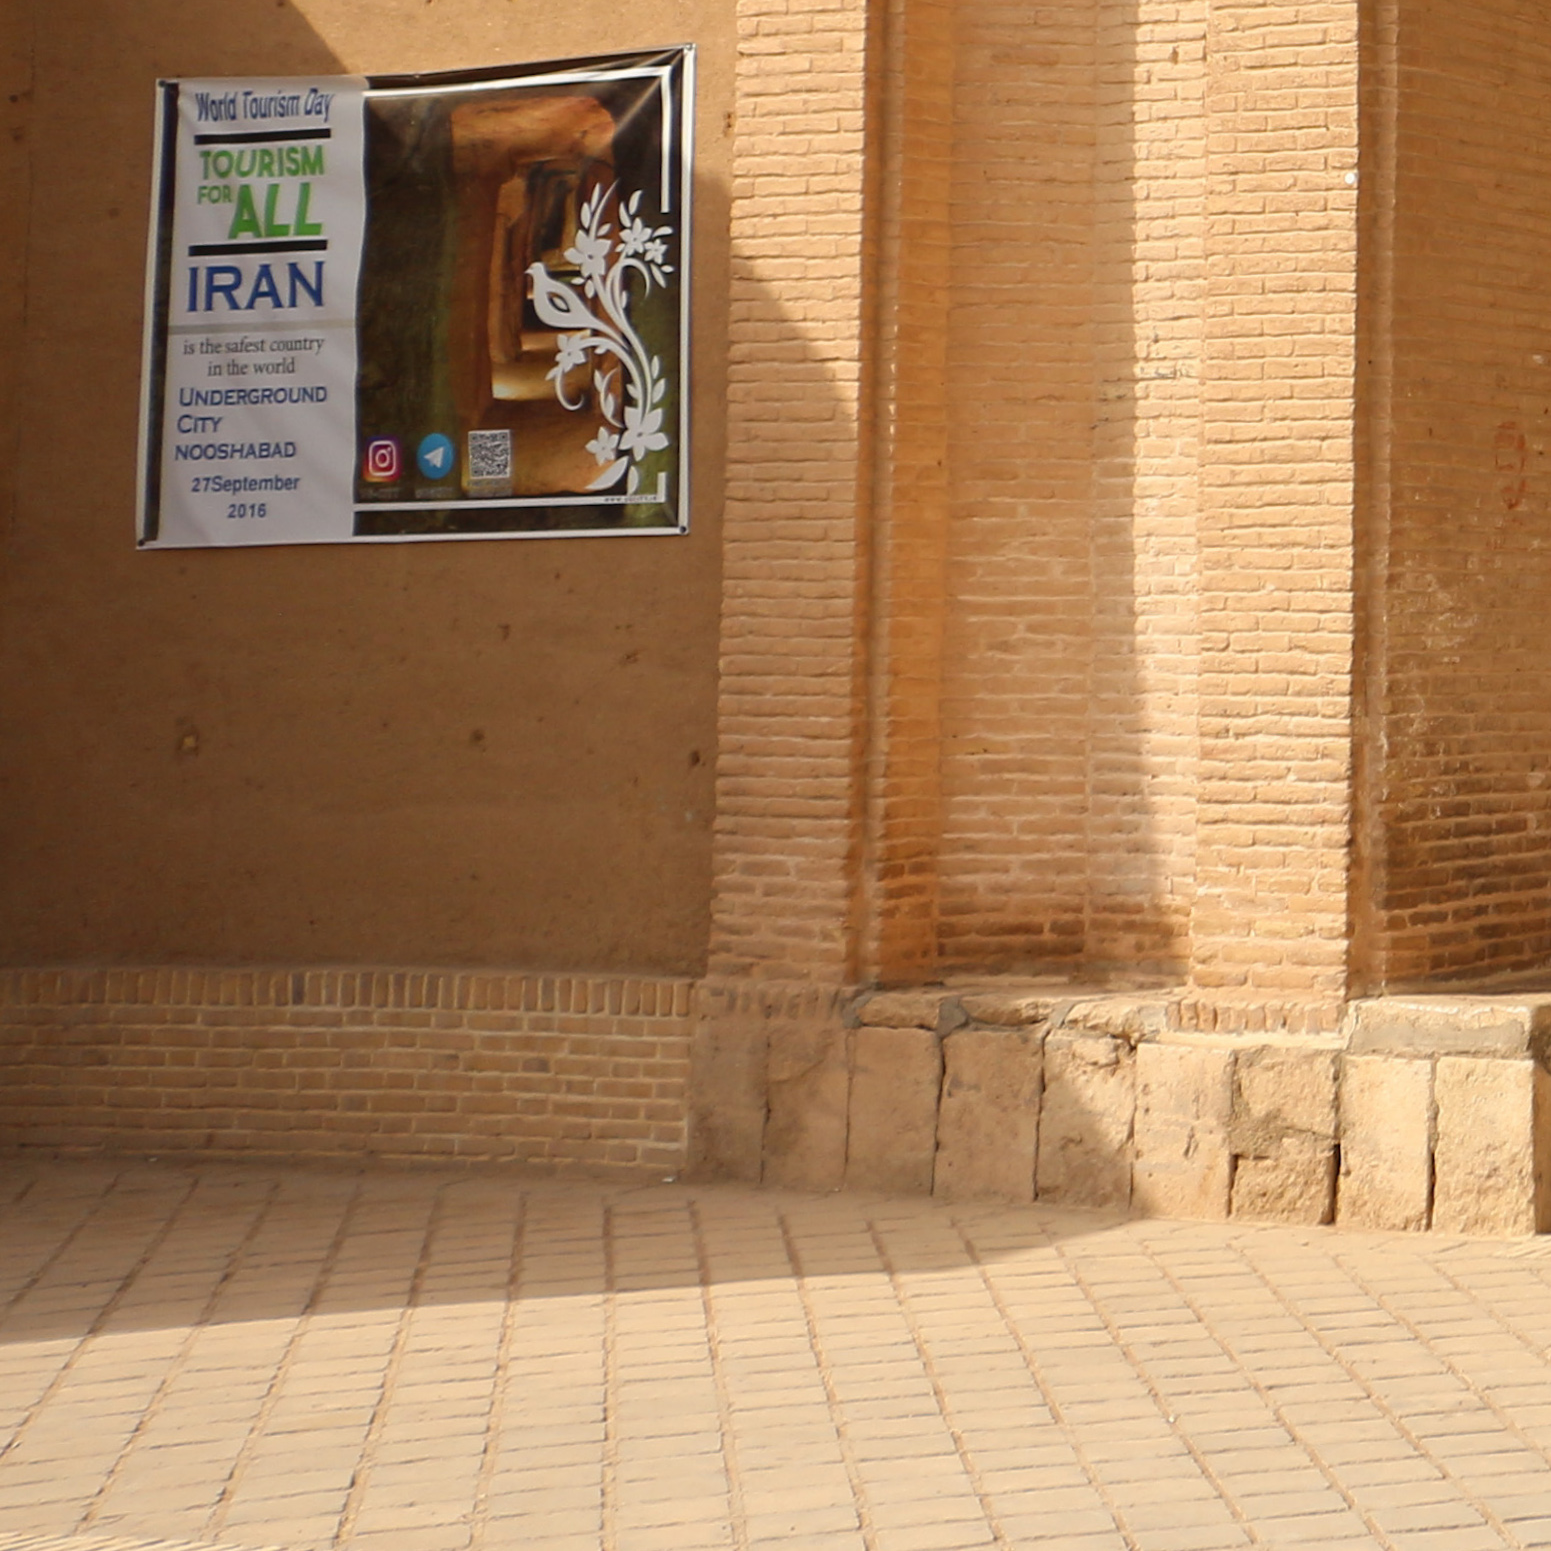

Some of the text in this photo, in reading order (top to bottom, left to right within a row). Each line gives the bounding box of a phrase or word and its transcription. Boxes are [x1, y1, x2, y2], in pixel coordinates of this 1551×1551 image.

[195, 87, 335, 123] World Tourism Day
[199, 145, 325, 180] TOURISM
[197, 182, 323, 239] FOR ALL
[186, 261, 325, 312] IRAN
[183, 336, 325, 355] is the safest country
[207, 357, 295, 376] in the world
[179, 386, 327, 406] UNDERGROUND
[174, 441, 297, 461] NOOSHABAD
[191, 474, 301, 495] 27September
[227, 502, 267, 519] 2016
